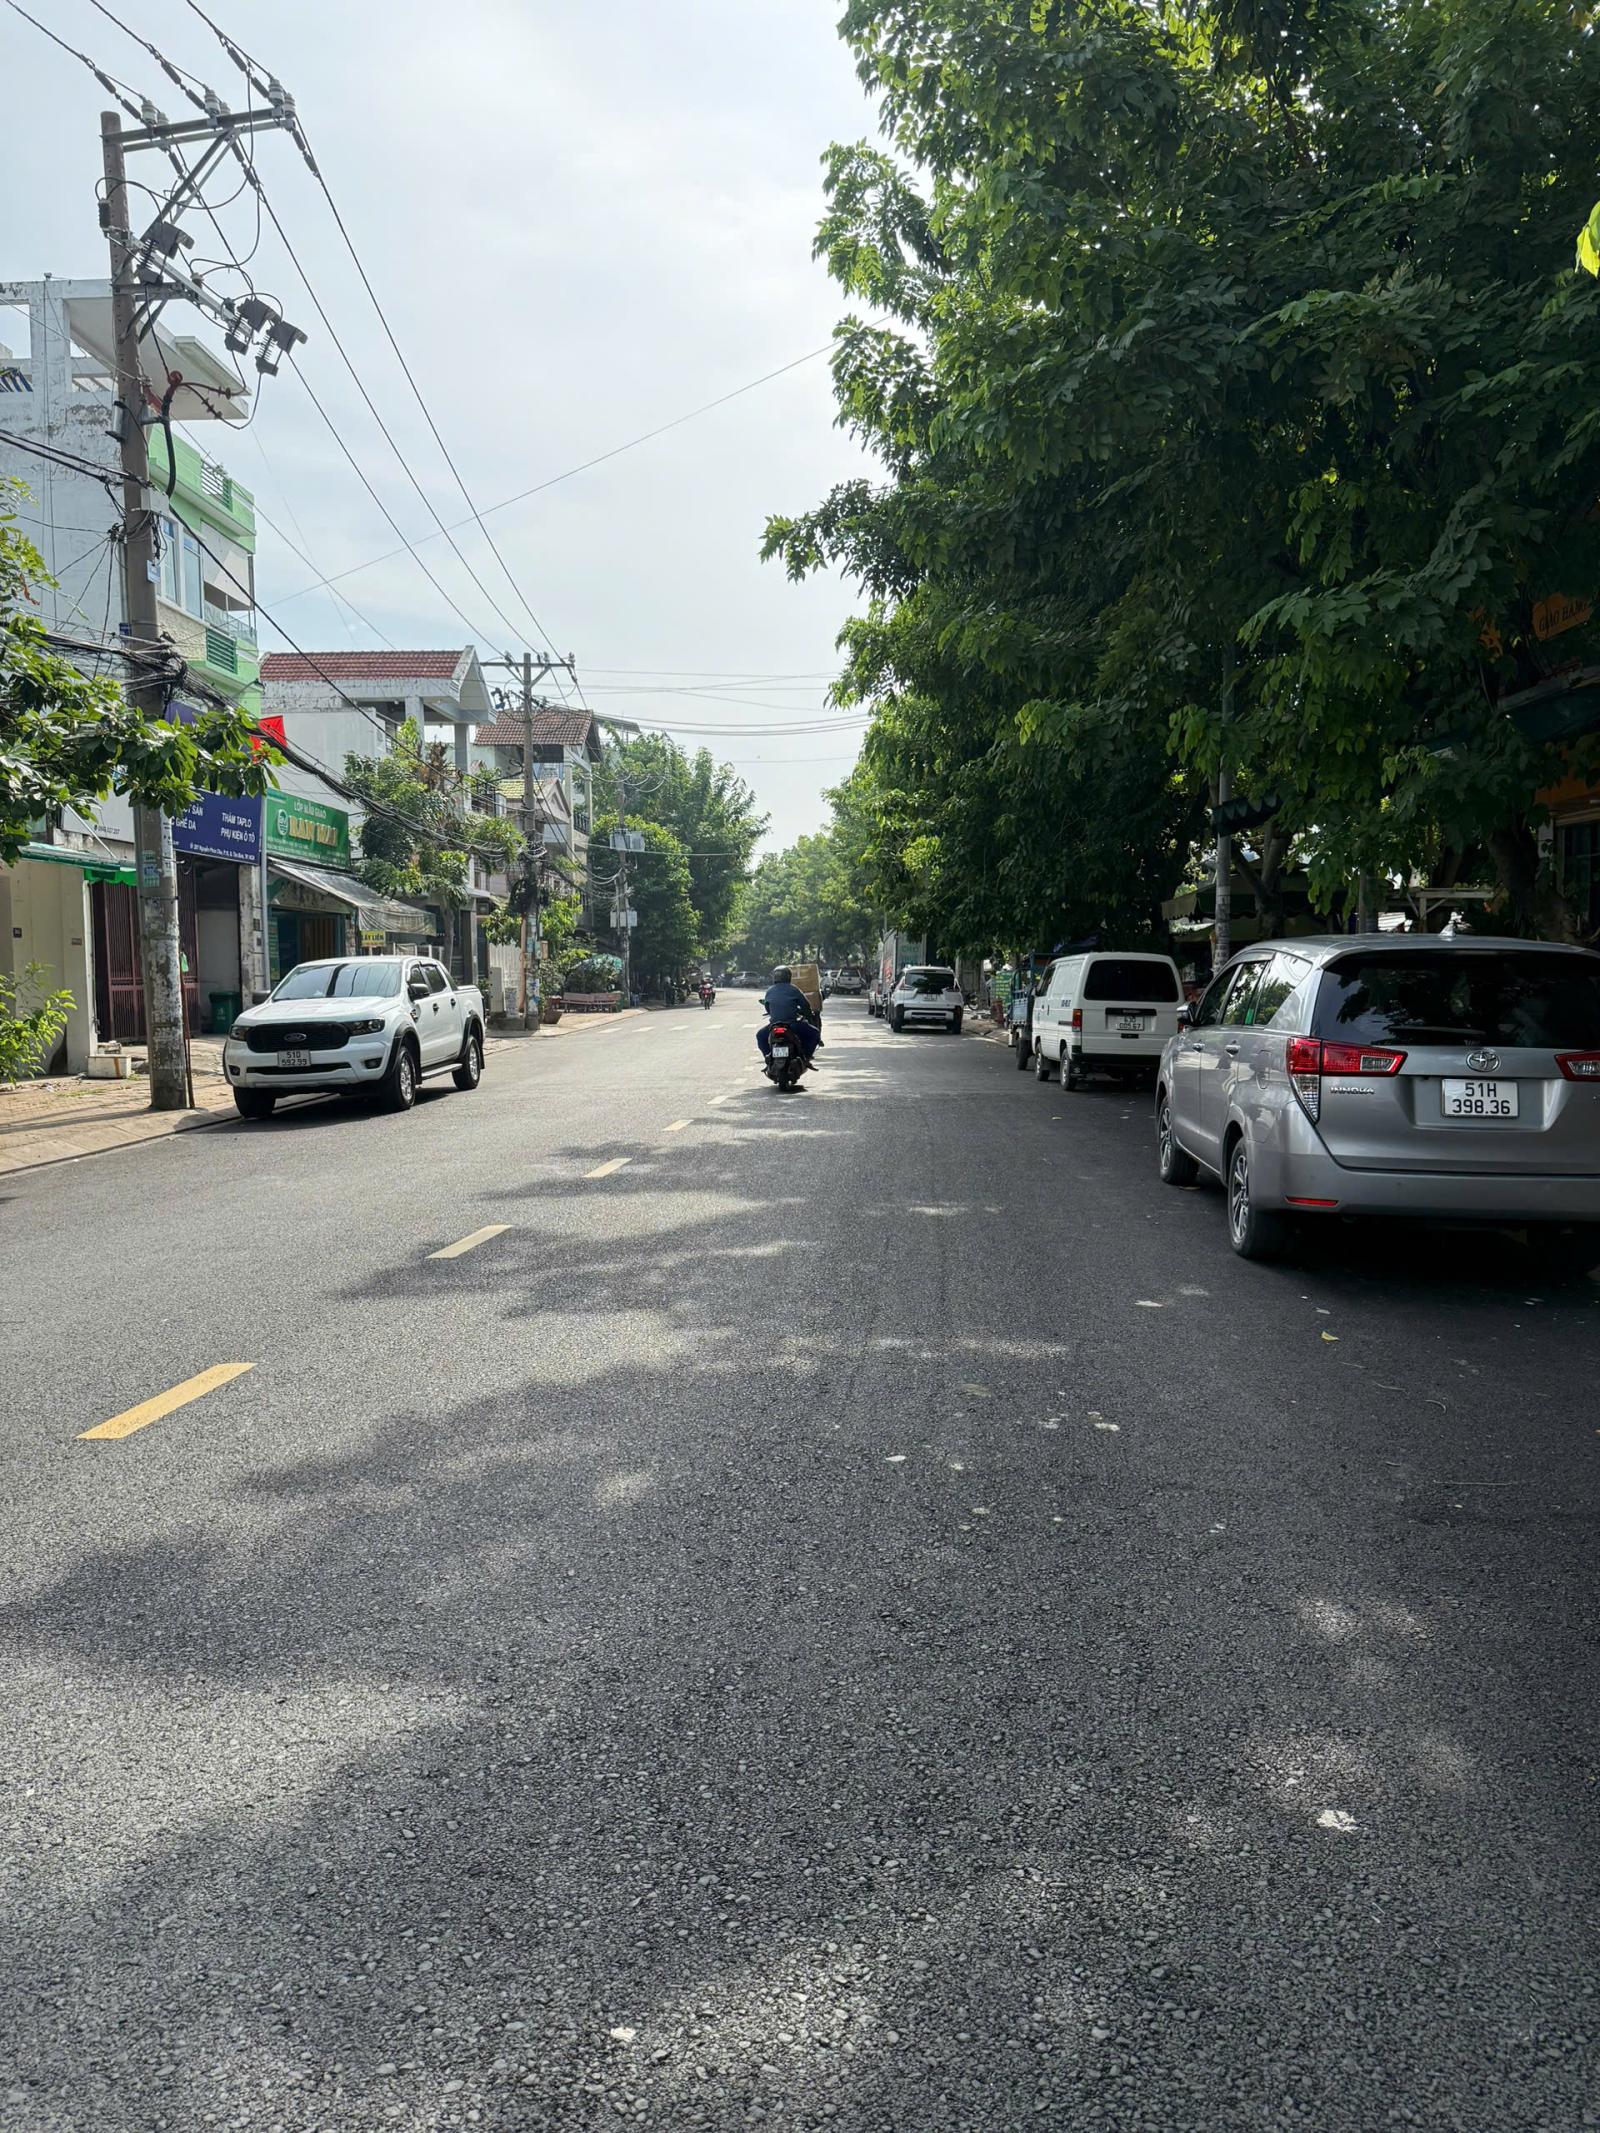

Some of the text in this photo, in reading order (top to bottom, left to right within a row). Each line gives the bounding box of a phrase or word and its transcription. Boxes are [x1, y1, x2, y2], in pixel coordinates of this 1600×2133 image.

[188, 819, 196, 830] DA
[1465, 1082, 1497, 1098] 51H
[1452, 1099, 1510, 1115] 398.36
